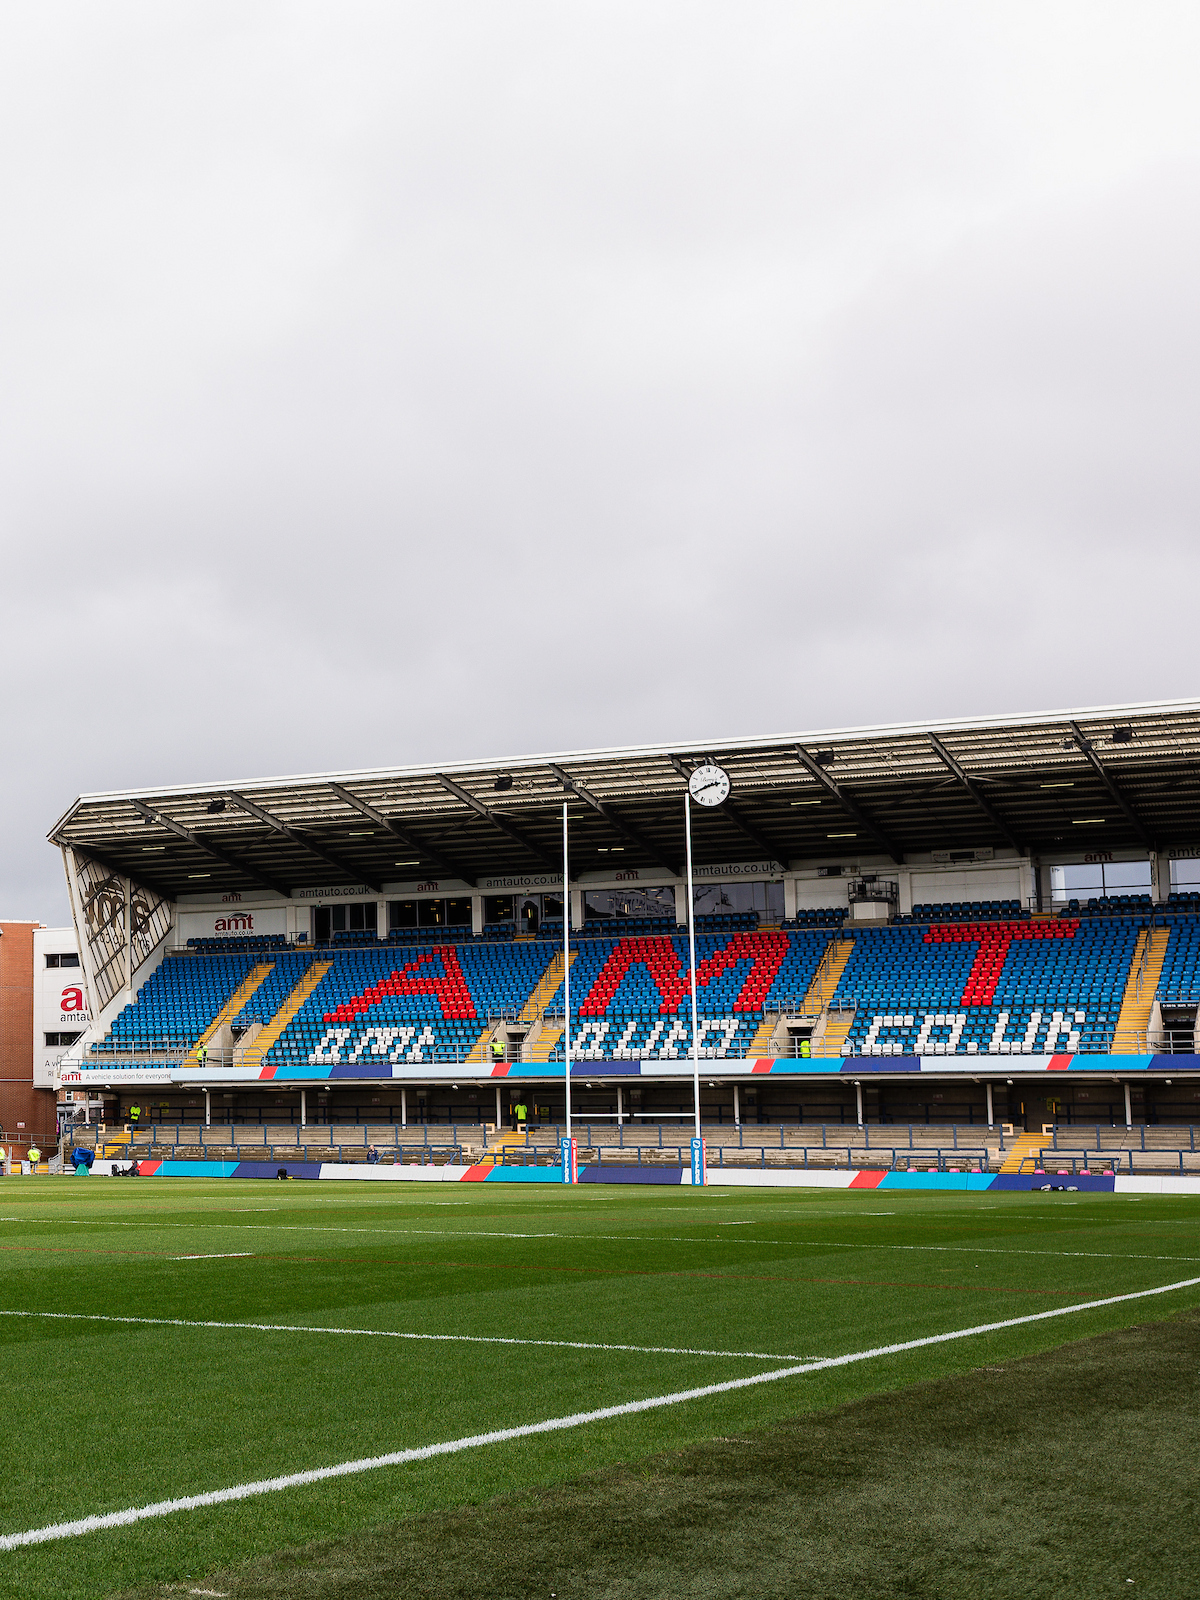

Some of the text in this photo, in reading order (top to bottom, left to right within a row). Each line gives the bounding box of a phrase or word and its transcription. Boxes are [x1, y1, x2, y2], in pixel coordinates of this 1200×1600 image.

[1084, 852, 1114, 863] amt
[486, 873, 563, 888] amtauto.co.uk
[615, 871, 640, 881] amt
[299, 885, 371, 899] amtauto.co.uk
[417, 881, 439, 892] amt
[222, 893, 243, 903] amt
[214, 914, 254, 932] amt
[60, 1072, 82, 1082] amt
